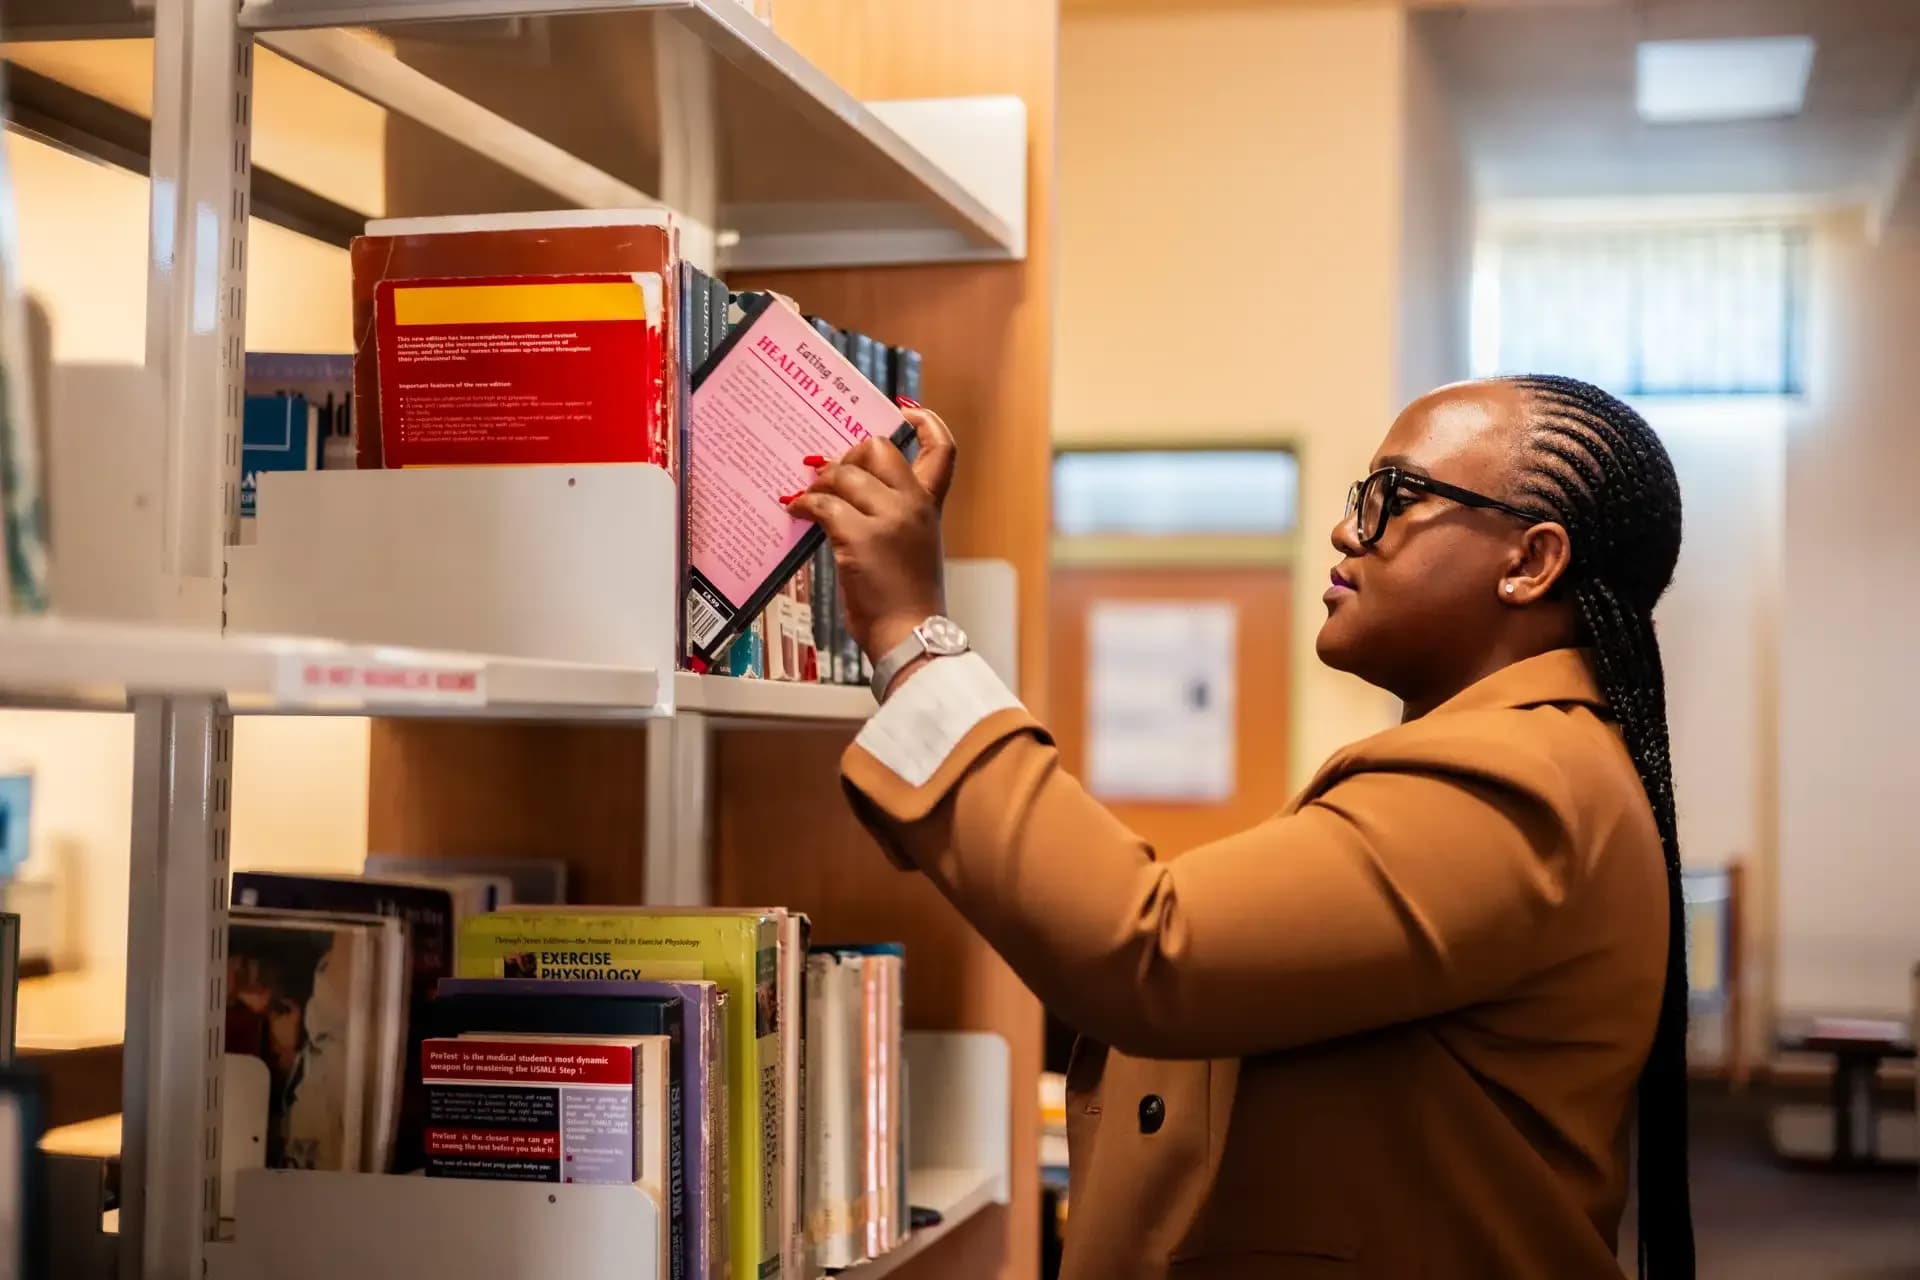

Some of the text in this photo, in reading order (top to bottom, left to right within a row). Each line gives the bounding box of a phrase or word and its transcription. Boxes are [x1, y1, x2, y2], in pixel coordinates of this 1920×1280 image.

[796, 342, 860, 404] Eating for a
[757, 336, 824, 398] HEALTHY
[822, 396, 872, 443] HEART
[664, 938, 700, 948] Physiology
[542, 952, 612, 966] EXERCISE
[542, 968, 642, 980] PHYSIOLOGY
[463, 1052, 470, 1060] is
[472, 1052, 484, 1061] the
[486, 1053, 516, 1062] medical
[518, 1054, 552, 1062] student's
[554, 1056, 574, 1064] most
[576, 1056, 608, 1066] dynamic
[430, 1064, 460, 1072] weapon
[463, 1063, 474, 1071] for
[476, 1064, 514, 1076] mastering
[530, 1066, 556, 1074] USMLE
[560, 1066, 576, 1076] Step
[486, 1134, 509, 1142] closest
[544, 1136, 554, 1145] get
[442, 1144, 463, 1152] seeing
[671, 1086, 682, 1218] SELENIUM
